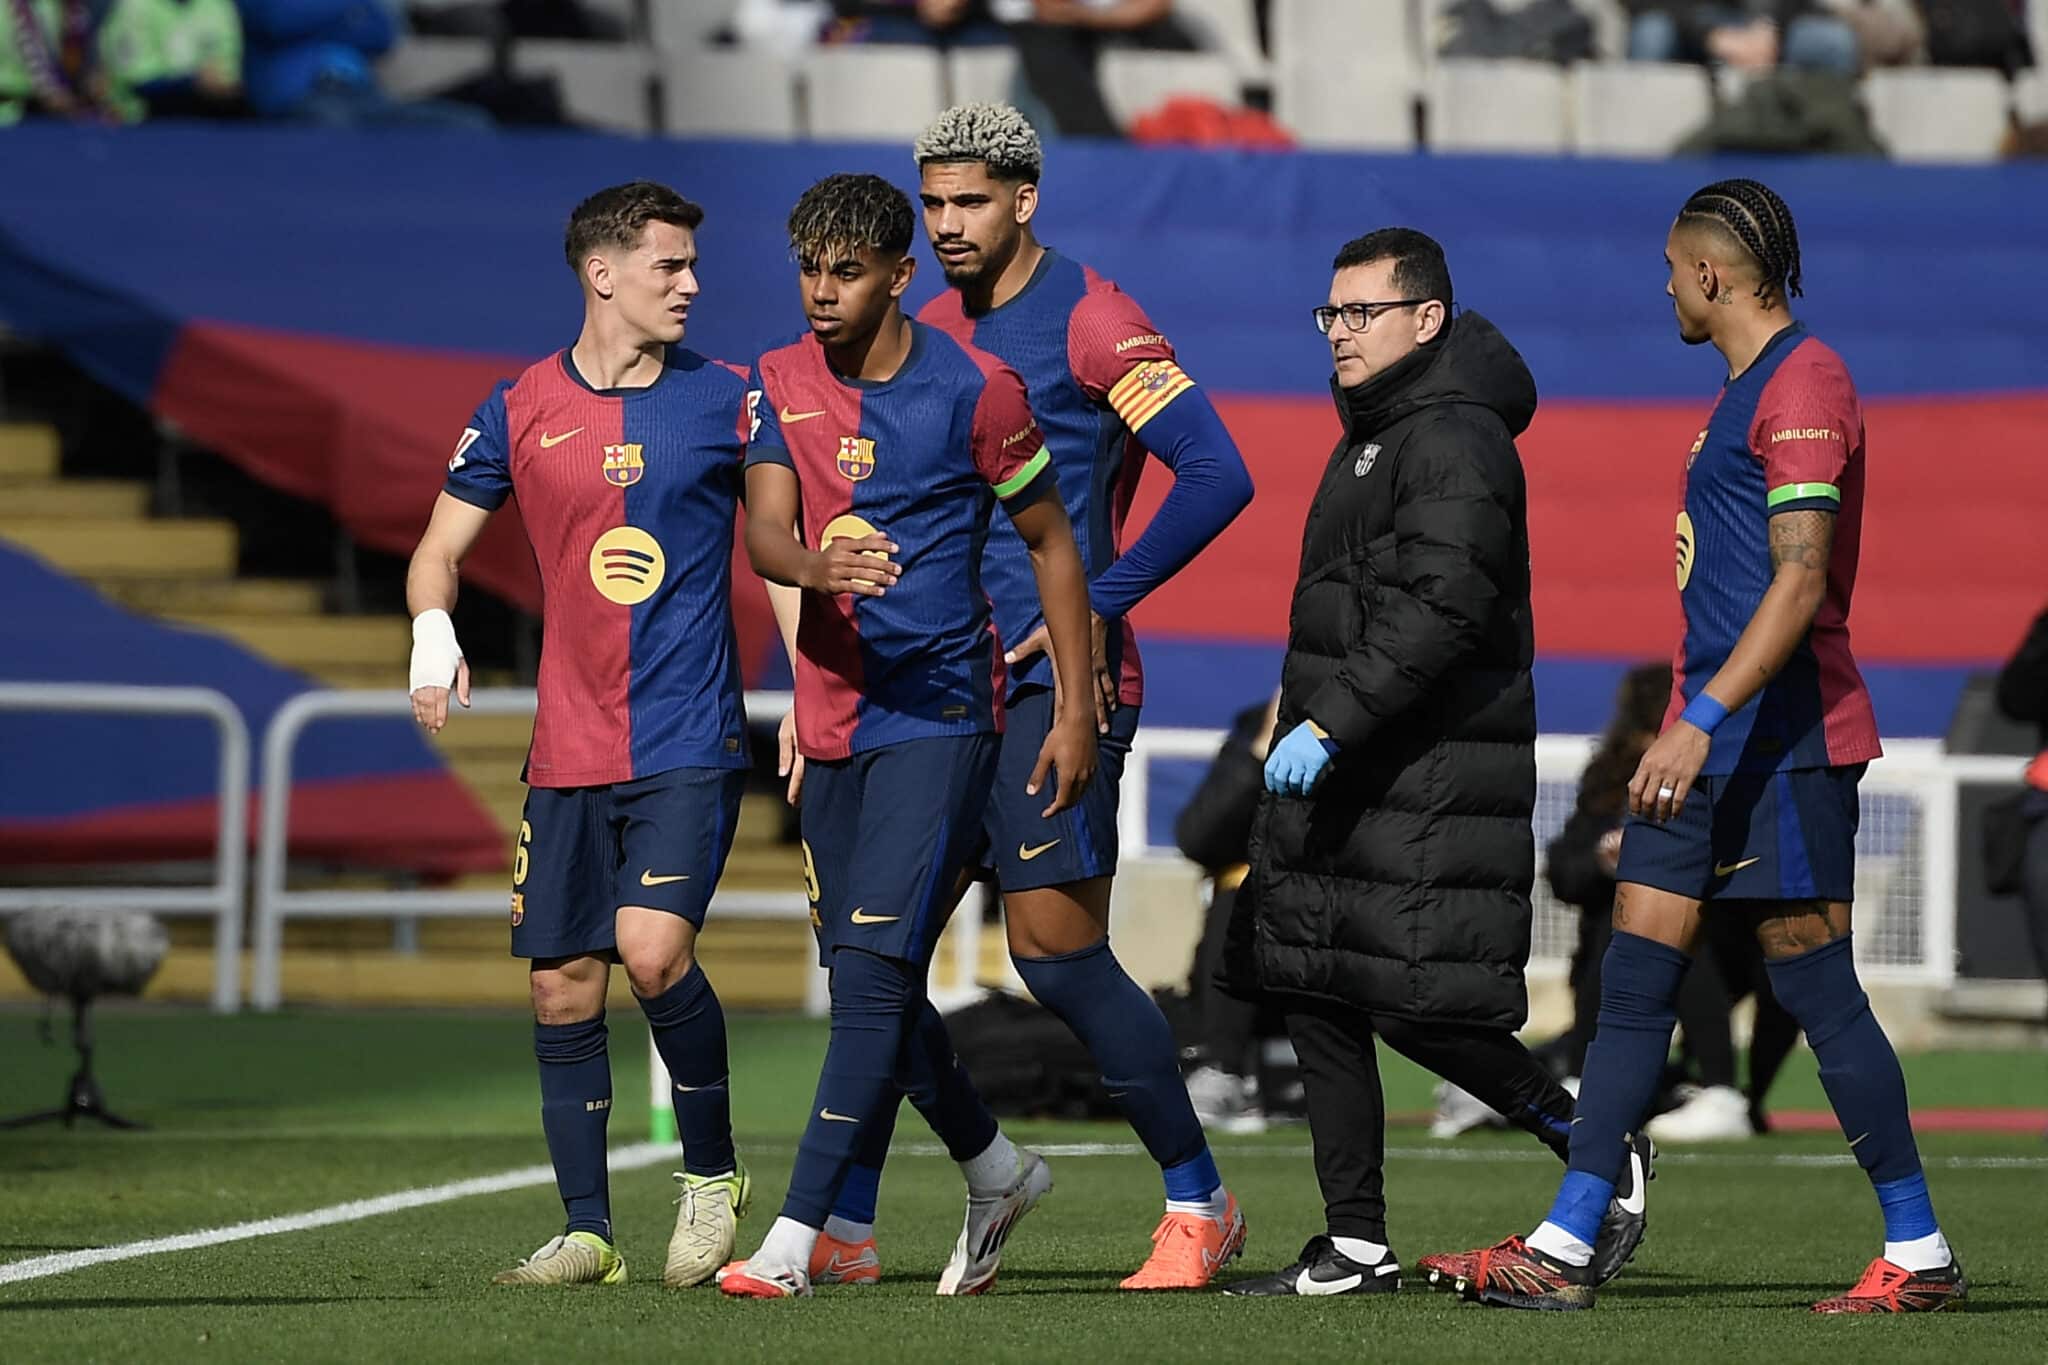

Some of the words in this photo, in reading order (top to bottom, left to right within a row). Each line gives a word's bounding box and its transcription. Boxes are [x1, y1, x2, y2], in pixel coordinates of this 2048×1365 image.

[1771, 428, 1830, 444] AMBILIGHT
[513, 820, 532, 886] 6
[801, 837, 820, 902] 9
